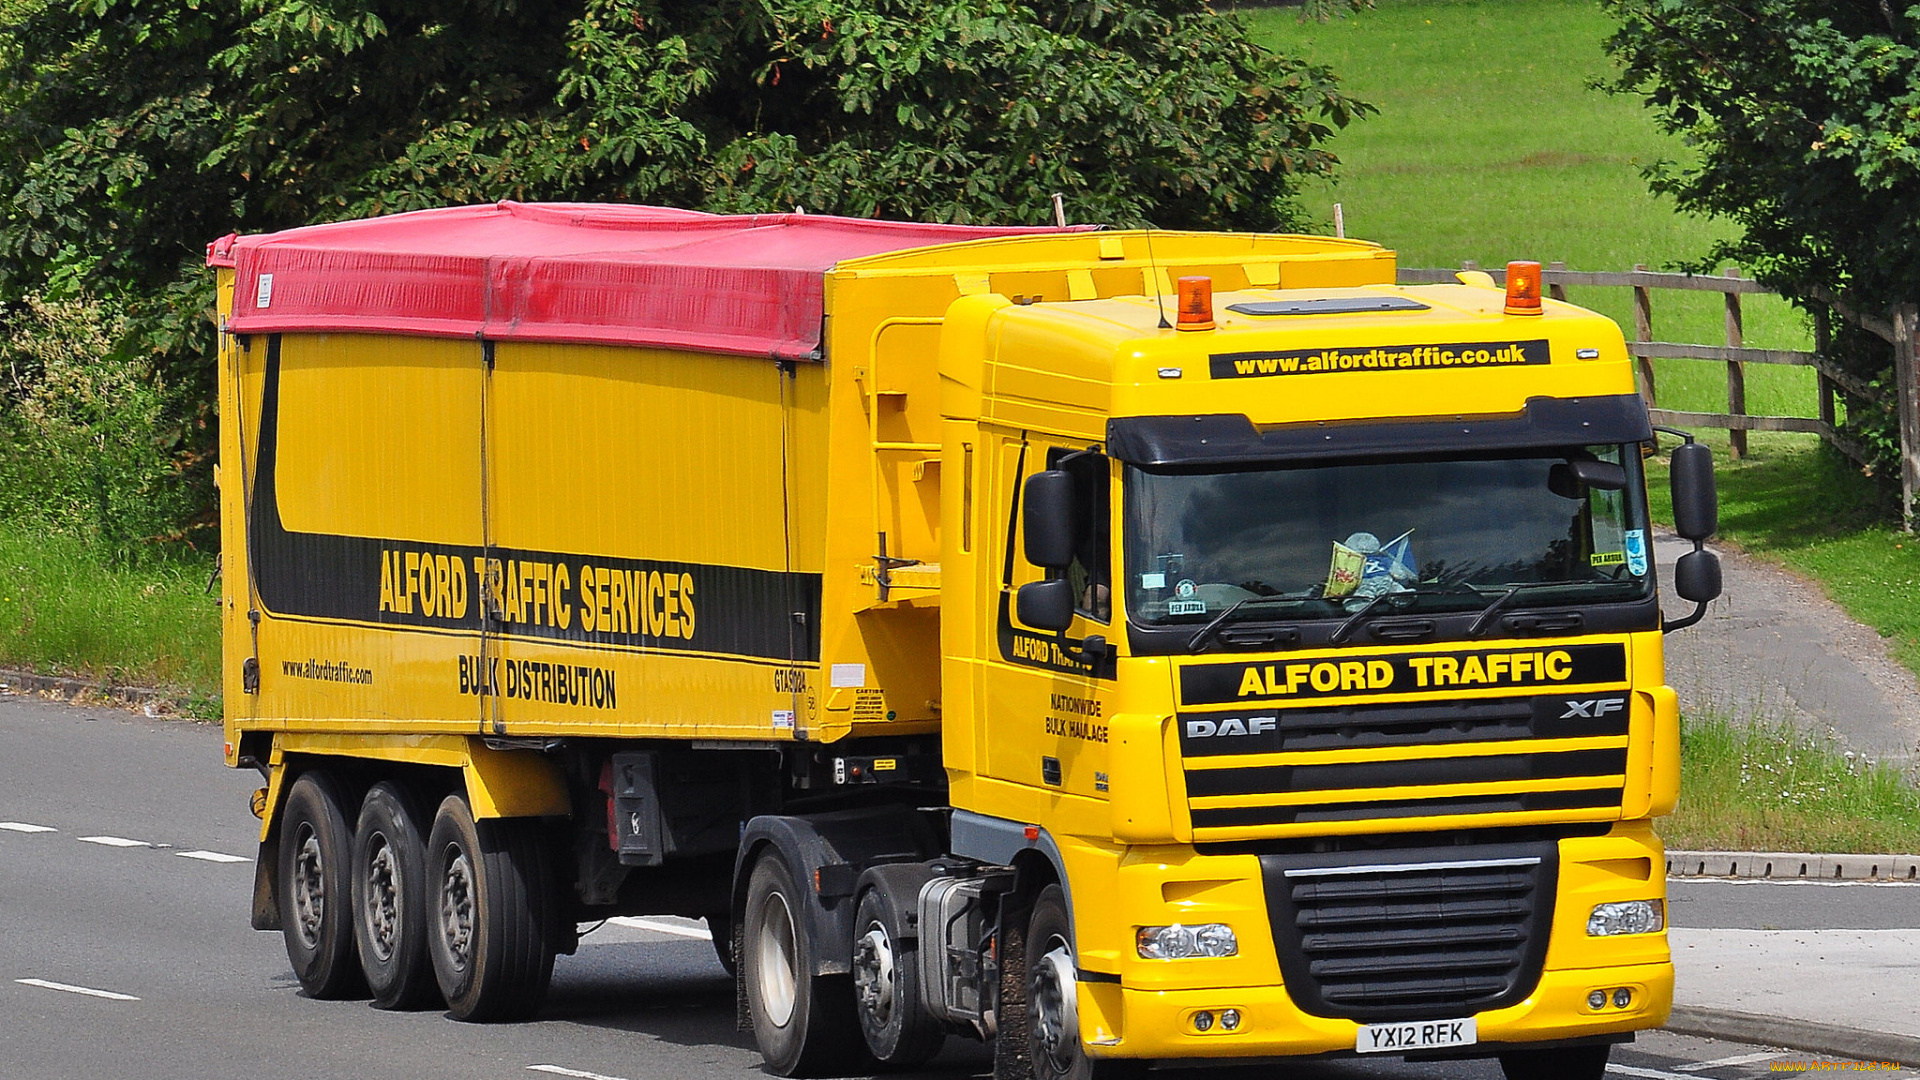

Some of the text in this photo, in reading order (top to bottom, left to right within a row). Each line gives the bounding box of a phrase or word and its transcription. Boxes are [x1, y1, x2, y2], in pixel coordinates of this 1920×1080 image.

[1234, 344, 1526, 375] www.alfordtraffic.co.uk
[379, 550, 695, 640] ALFORD TRAFFIC SERVICES
[1012, 635, 1049, 663] ALFORD
[282, 658, 373, 685] www.alfordtraffic.com
[506, 659, 617, 710] DISTRIBUTION
[1237, 650, 1573, 696] ALFORD TRAFFIC
[1051, 693, 1102, 718] NATIONWIDE
[1560, 698, 1624, 719] XF
[1046, 716, 1109, 743] BULK HAULAGE
[1186, 717, 1276, 738] DAF
[1370, 1022, 1463, 1048] YX12 RFK
